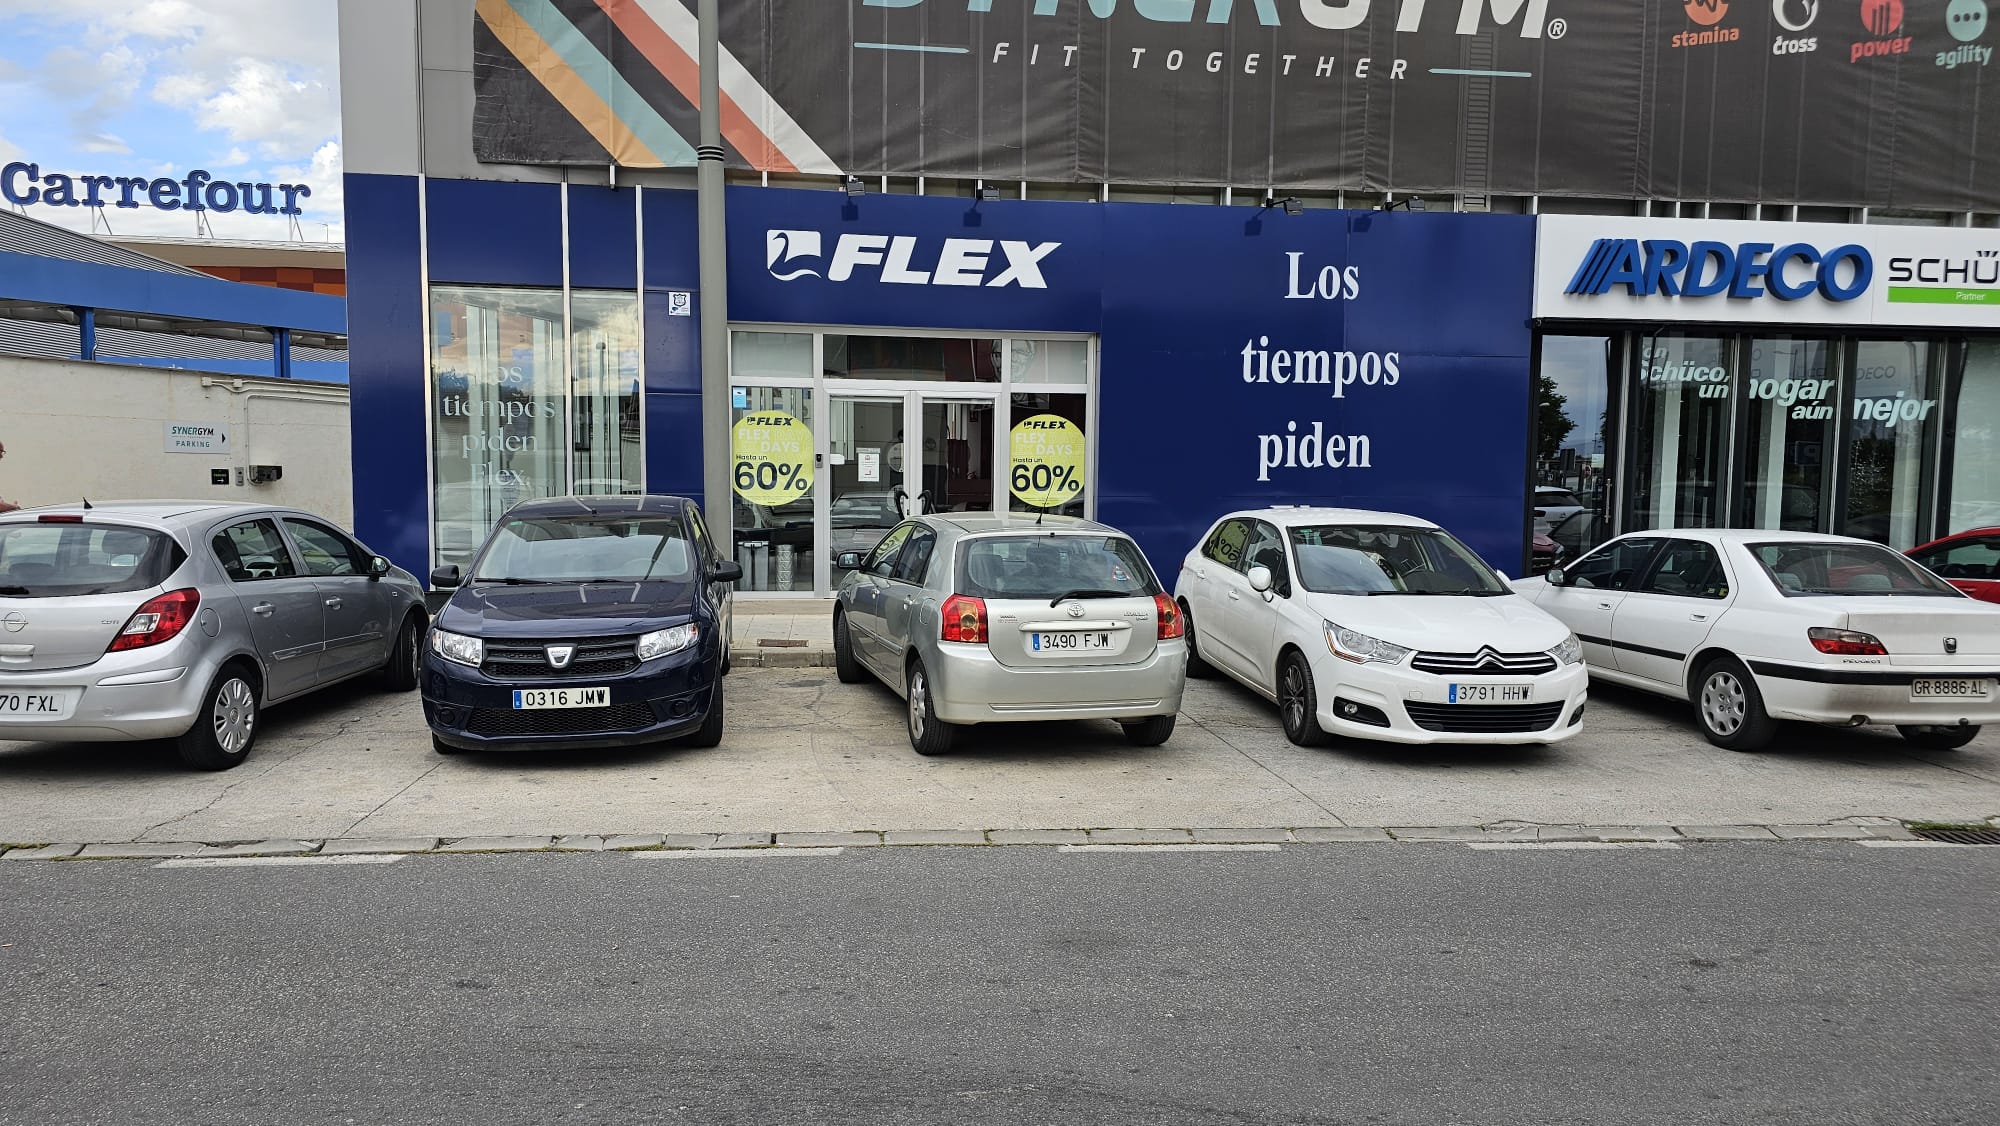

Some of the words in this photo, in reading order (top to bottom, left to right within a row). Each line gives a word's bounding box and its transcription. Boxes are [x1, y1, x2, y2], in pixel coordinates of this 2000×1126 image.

[1672, 26, 1739, 47] stamina
[1851, 36, 1912, 62] power
[1936, 45, 1992, 69] agility
[992, 42, 1078, 67] FIT
[1131, 48, 1408, 80] TOGETHER
[0, 161, 311, 215] Carrefour
[828, 233, 1063, 289] FLEX
[1563, 239, 1874, 302] ARDECO
[1284, 251, 1360, 300] Los
[1955, 291, 1986, 301] Partner
[1241, 336, 1400, 399] tiempos
[1699, 384, 1729, 398] un
[442, 394, 556, 425] tiempos
[1792, 401, 1834, 420] aún
[172, 426, 214, 436] SYNERGYM
[756, 417, 794, 426] FLEX
[1033, 421, 1068, 429] FLEX
[176, 440, 210, 448] PARKING
[462, 427, 538, 459] piden
[738, 429, 770, 440] FLEX
[1015, 432, 1046, 443] FLEX
[761, 442, 800, 453] DAYS
[1036, 444, 1073, 456] DAYS
[1257, 420, 1372, 481] piden
[734, 461, 808, 491] 60%
[1011, 464, 1080, 492] 60%
[1043, 634, 1077, 649] 3490
[1084, 633, 1109, 648] FJW
[526, 690, 568, 706] 0316
[575, 689, 606, 705] JMW
[1459, 686, 1495, 700] 3791
[1502, 686, 1530, 700] HHW
[26, 695, 58, 711] FXL
